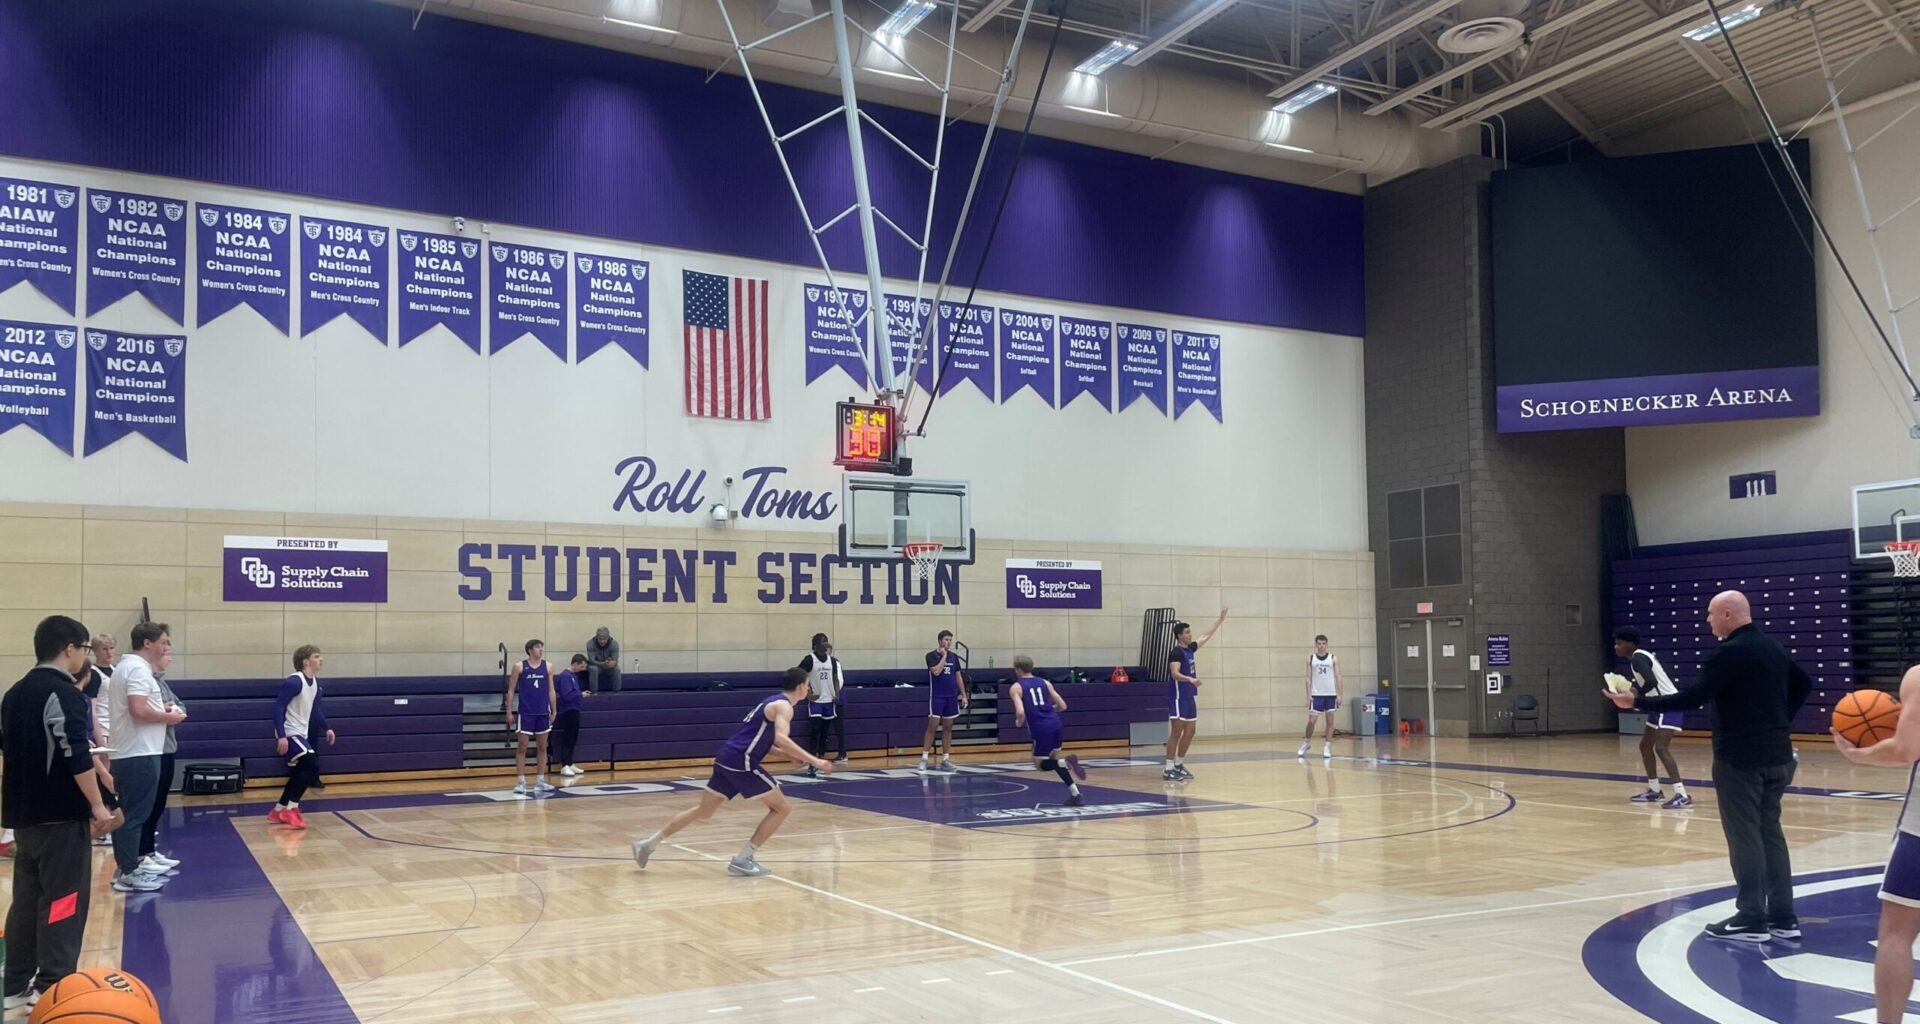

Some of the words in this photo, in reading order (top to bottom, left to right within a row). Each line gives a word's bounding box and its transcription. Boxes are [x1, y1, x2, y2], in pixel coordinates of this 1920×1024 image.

[8, 185, 46, 203] 1981
[0, 206, 54, 223] AIAW
[119, 199, 157, 216] 1982
[109, 218, 166, 236] NCAA
[225, 212, 262, 230] 1984
[217, 232, 270, 249] NCAA
[327, 225, 362, 243] 1984
[0, 239, 66, 253] ampions
[108, 235, 166, 249] National
[423, 238, 455, 254] 1985
[97, 249, 176, 265] Champions
[216, 247, 272, 261] National
[319, 244, 370, 261] NCAA
[514, 250, 544, 266] 1986
[17, 259, 38, 268] Cross
[41, 261, 71, 273] Country
[207, 260, 281, 277] Champions
[318, 259, 371, 273] National
[416, 256, 463, 272] NCAA
[598, 260, 627, 276] 1986
[92, 267, 126, 278] Women's
[129, 271, 149, 280] Cross
[152, 274, 180, 285] Country
[310, 272, 379, 288] Champions
[415, 271, 464, 284] National
[506, 267, 551, 283] NCAA
[202, 279, 234, 289] Women's
[237, 282, 256, 291] Cross
[258, 285, 285, 296] Country
[406, 284, 472, 299] Champions
[506, 282, 552, 295] National
[591, 278, 633, 293] NCAA
[311, 290, 330, 300] Men's
[333, 293, 351, 302] Cross
[354, 295, 379, 306] Country
[498, 294, 560, 309] Champions
[591, 292, 634, 304] National
[410, 302, 428, 310] Men's
[430, 304, 450, 313] Indoor
[583, 304, 642, 318] Champions
[818, 306, 854, 320] NCAA
[499, 312, 516, 320] Men's
[518, 314, 535, 322] Cross
[537, 316, 559, 326] Country
[818, 320, 847, 329] Nation
[1016, 314, 1039, 328] 2004
[580, 320, 605, 329] Women's
[607, 323, 623, 332] Cross
[625, 325, 646, 335] Country
[950, 322, 982, 335] NCAA
[1075, 324, 1096, 337] 2005
[1133, 329, 1151, 340] 2009
[5, 328, 45, 345] 2012
[1012, 330, 1043, 342] NCAA
[1187, 336, 1205, 348] 2011
[117, 338, 154, 354] 2016
[1012, 342, 1044, 352] National
[1071, 339, 1100, 350] NCAA
[1129, 343, 1156, 354] NCAA
[0, 349, 55, 365] NCAA
[1006, 352, 1049, 363] Champions
[1070, 350, 1101, 360] National
[1128, 355, 1157, 364] National
[1183, 350, 1210, 361] NCAA
[107, 358, 164, 373] NCAA
[1065, 360, 1106, 371] Champions
[1123, 365, 1162, 375] Champions
[1182, 362, 1211, 372] National
[106, 376, 165, 388] National
[1178, 372, 1216, 382] Champions
[0, 385, 66, 396] ampions
[96, 389, 174, 402] Champions
[0, 404, 48, 415] Volleyball
[95, 411, 122, 420] Men's
[126, 414, 175, 423] Basketball
[613, 456, 706, 514] Roll
[741, 466, 837, 521] Toms
[277, 539, 325, 548] PRESENTED
[328, 541, 338, 549] BY
[281, 565, 328, 578] Supply
[330, 566, 369, 577] Chain
[458, 543, 736, 603] STUDENT
[756, 552, 960, 605] SECTION
[281, 578, 343, 588] Solutions
[1040, 581, 1067, 590] Supply
[1068, 581, 1090, 590] Chain
[1040, 590, 1076, 598] Solutions
[820, 672, 828, 680] 22
[534, 679, 539, 688] 4
[1030, 687, 1045, 705] 11
